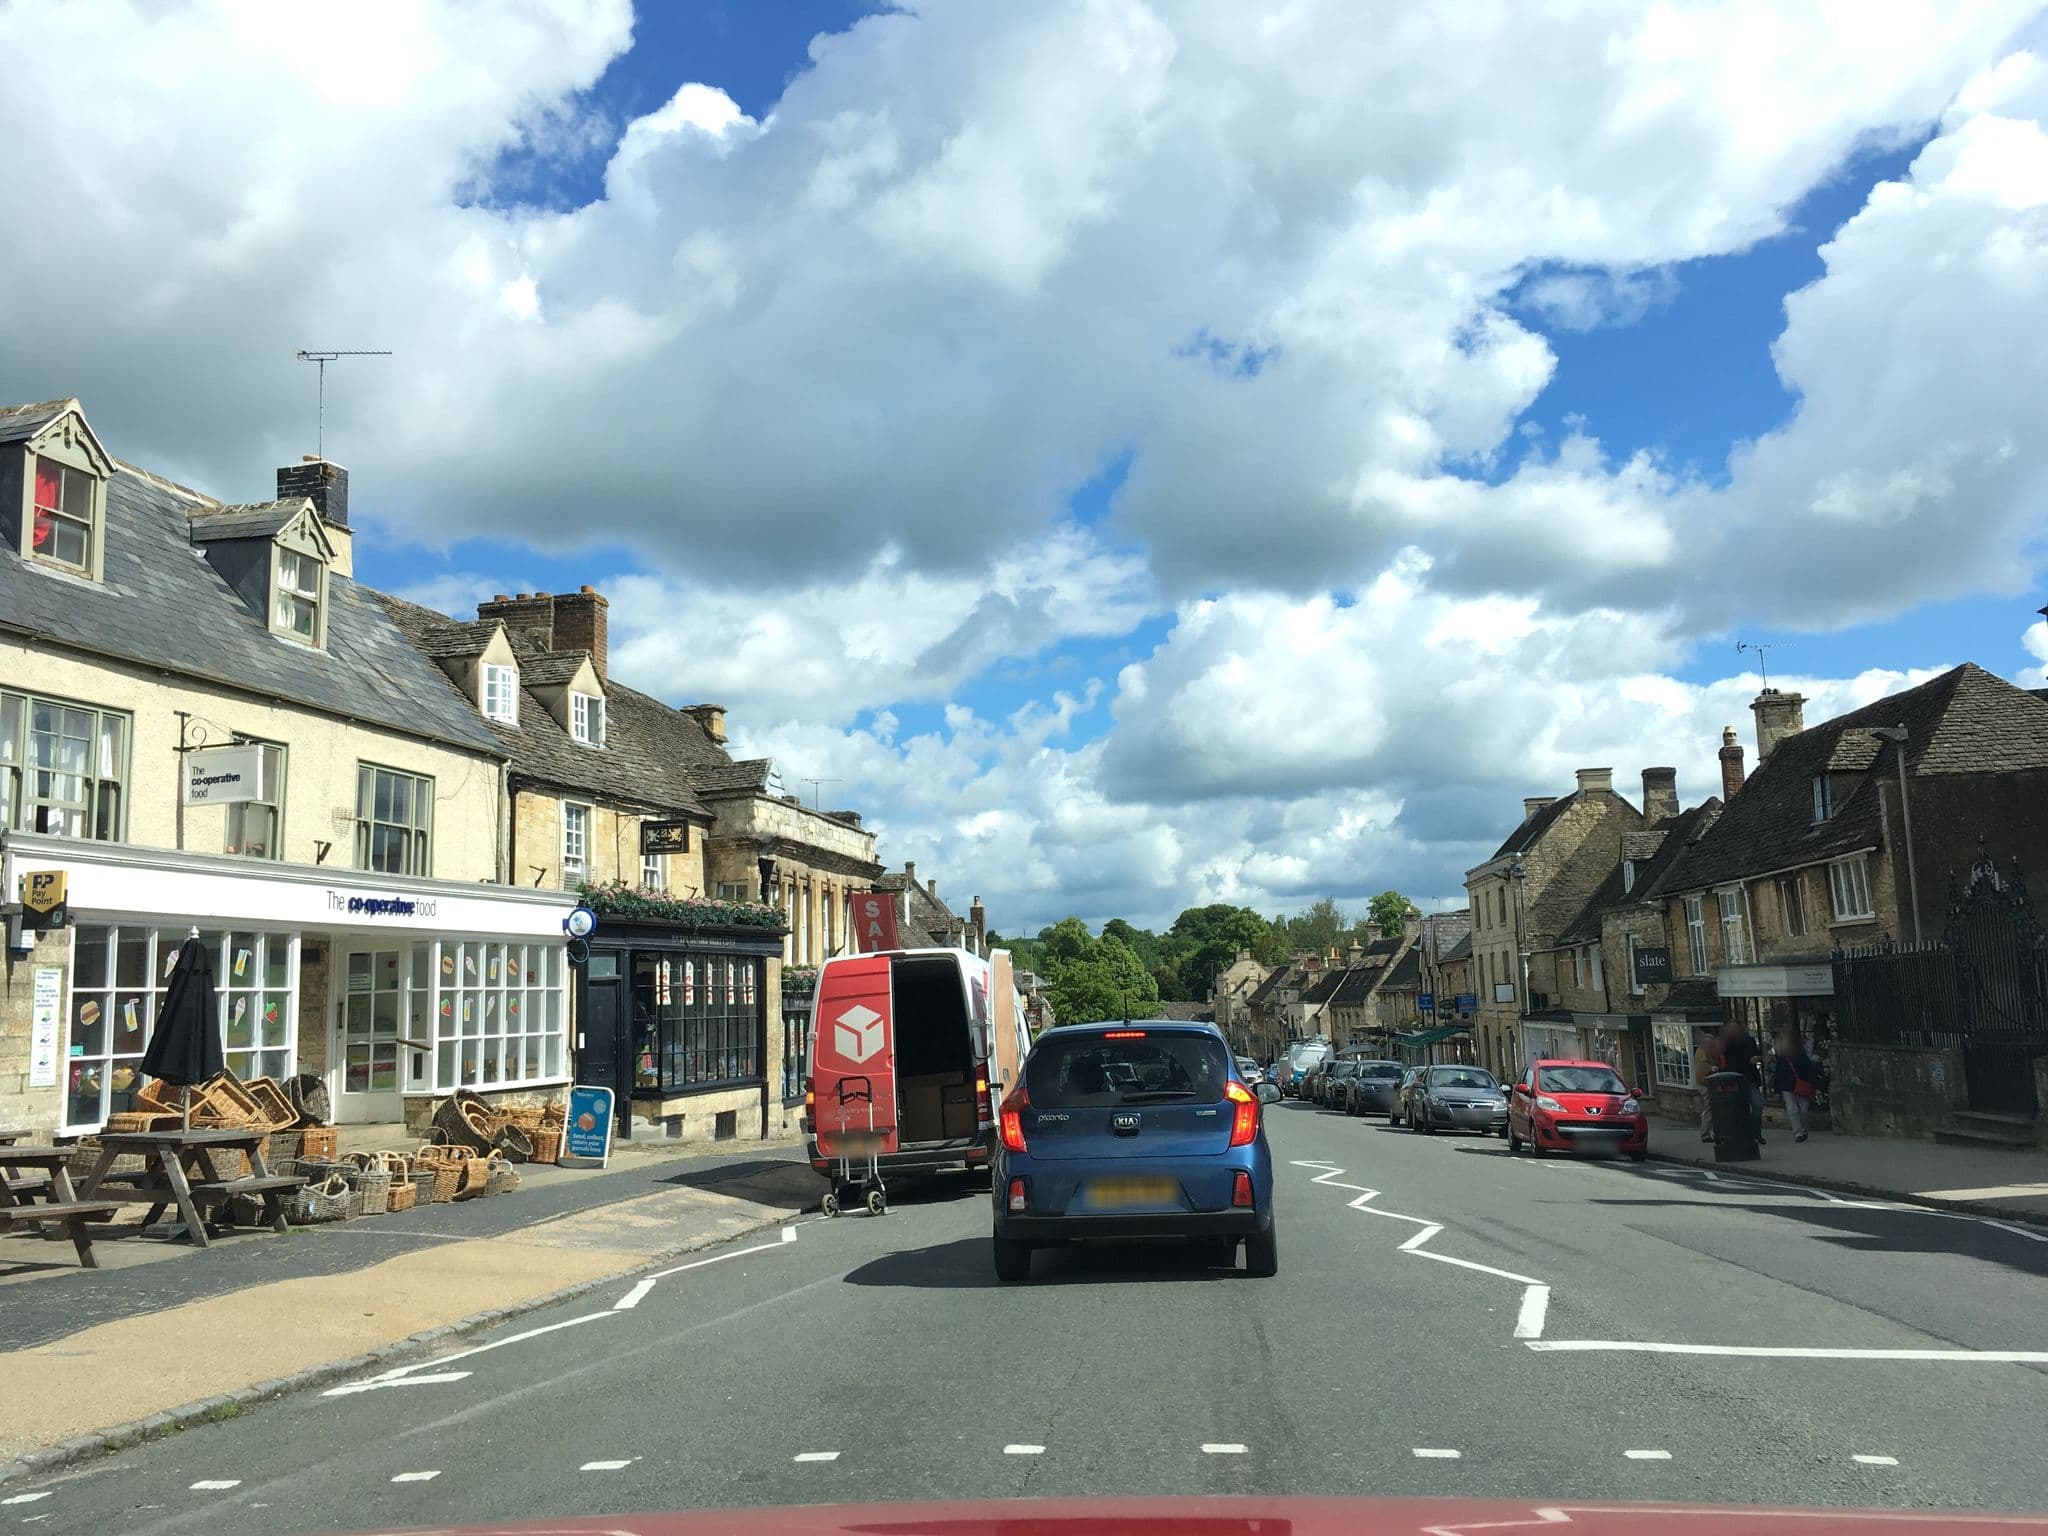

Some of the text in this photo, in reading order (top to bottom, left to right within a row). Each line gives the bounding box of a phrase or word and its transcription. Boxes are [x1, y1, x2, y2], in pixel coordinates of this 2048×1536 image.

[192, 766, 205, 776] The
[192, 773, 241, 786] co-operative
[192, 788, 208, 799] food
[32, 890, 46, 898] Pay
[326, 890, 436, 918] The co-operative food
[1640, 954, 1666, 967] slate
[1038, 1113, 1135, 1125] picanto KIA
